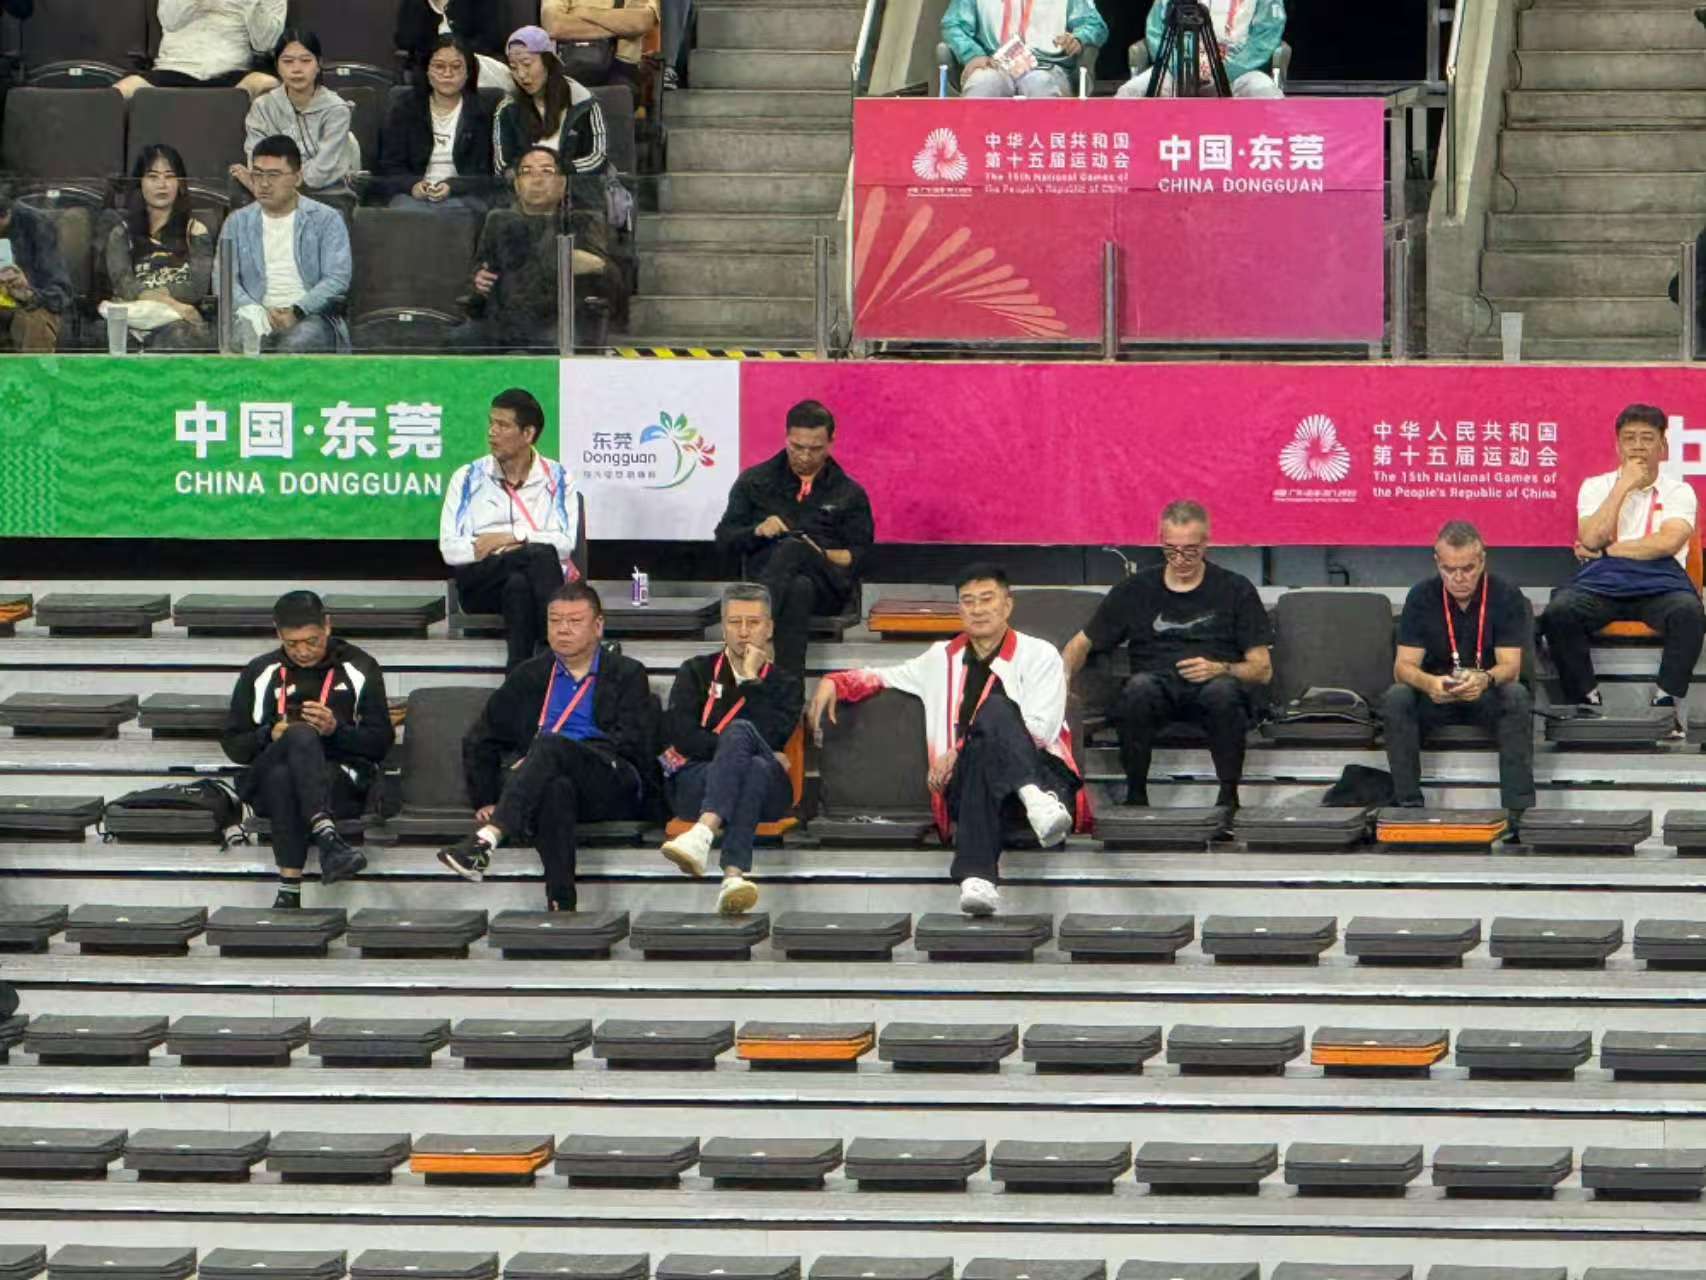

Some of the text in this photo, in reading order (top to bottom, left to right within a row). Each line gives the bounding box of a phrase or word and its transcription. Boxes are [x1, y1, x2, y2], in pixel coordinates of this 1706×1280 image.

[985, 132, 1130, 149] 中华人民共和国
[985, 151, 1130, 168] 第十五届运动会
[1158, 134, 1326, 173] 中国·东莞
[1158, 177, 1325, 193] CHINA DONGGUAN
[175, 400, 443, 460] 中国·东莞
[1373, 421, 1558, 442] 中华人民共和国
[592, 432, 633, 450] 东莞
[583, 450, 657, 467] Dongguan
[1373, 445, 1558, 467] 第十五届运动会
[175, 471, 442, 495] CHINA DONGGUAN
[1373, 471, 1557, 484] The 15th National Games of
[1372, 487, 1392, 498] the
[1395, 486, 1446, 500] People's
[1449, 487, 1502, 501] Republic
[1505, 487, 1518, 499] of
[1521, 488, 1557, 500] China
